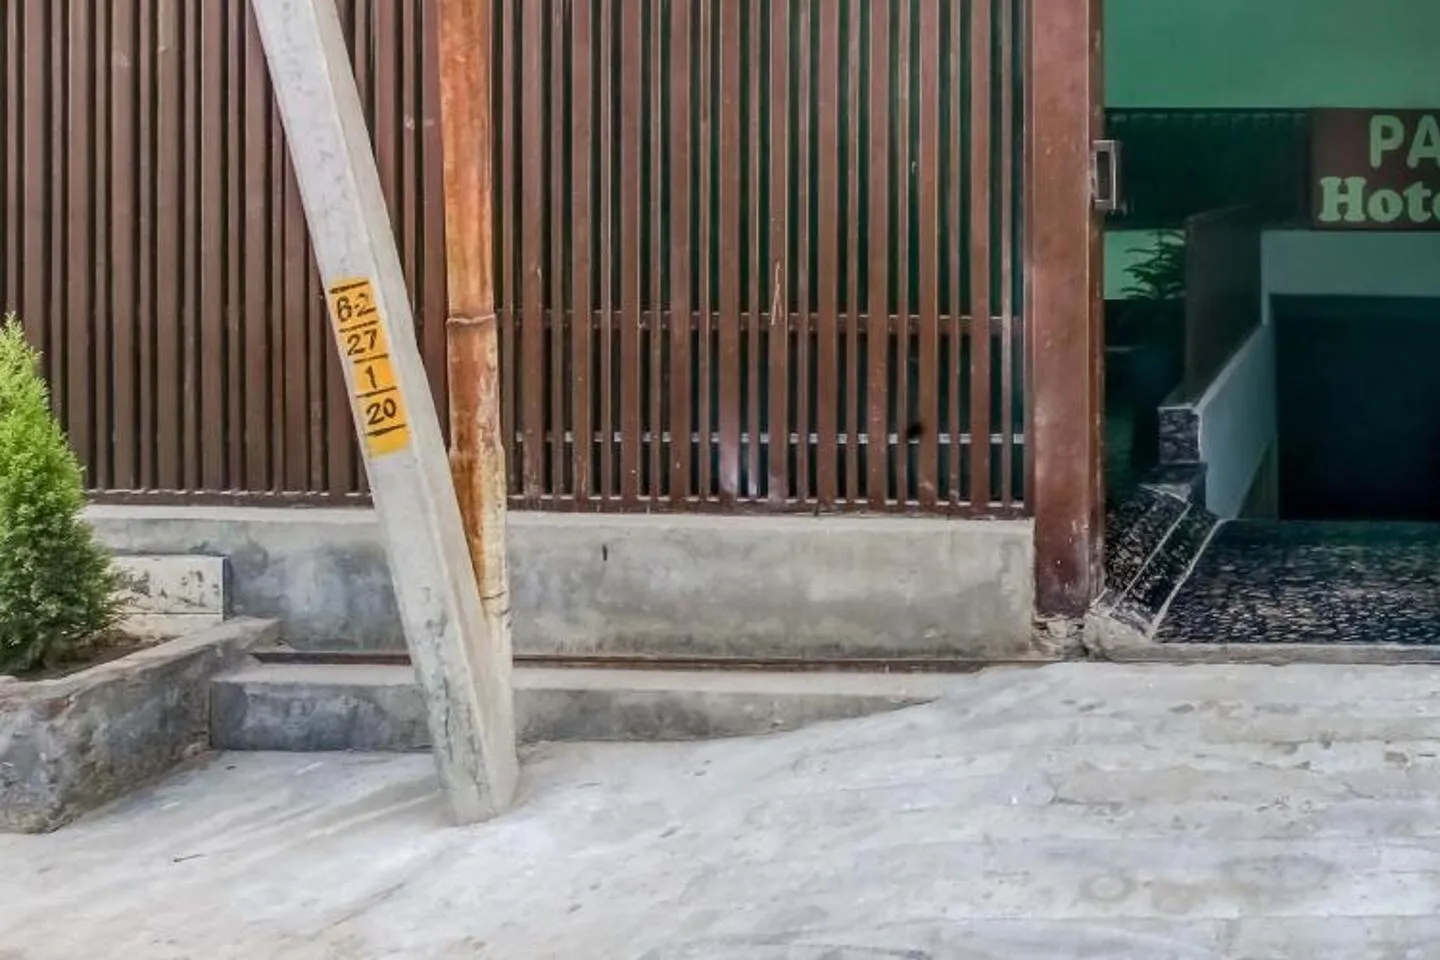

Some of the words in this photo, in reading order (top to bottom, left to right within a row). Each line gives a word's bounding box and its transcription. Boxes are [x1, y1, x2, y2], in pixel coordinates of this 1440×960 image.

[346, 329, 378, 356] 27
[364, 365, 378, 389] 1
[365, 397, 397, 426] 20
